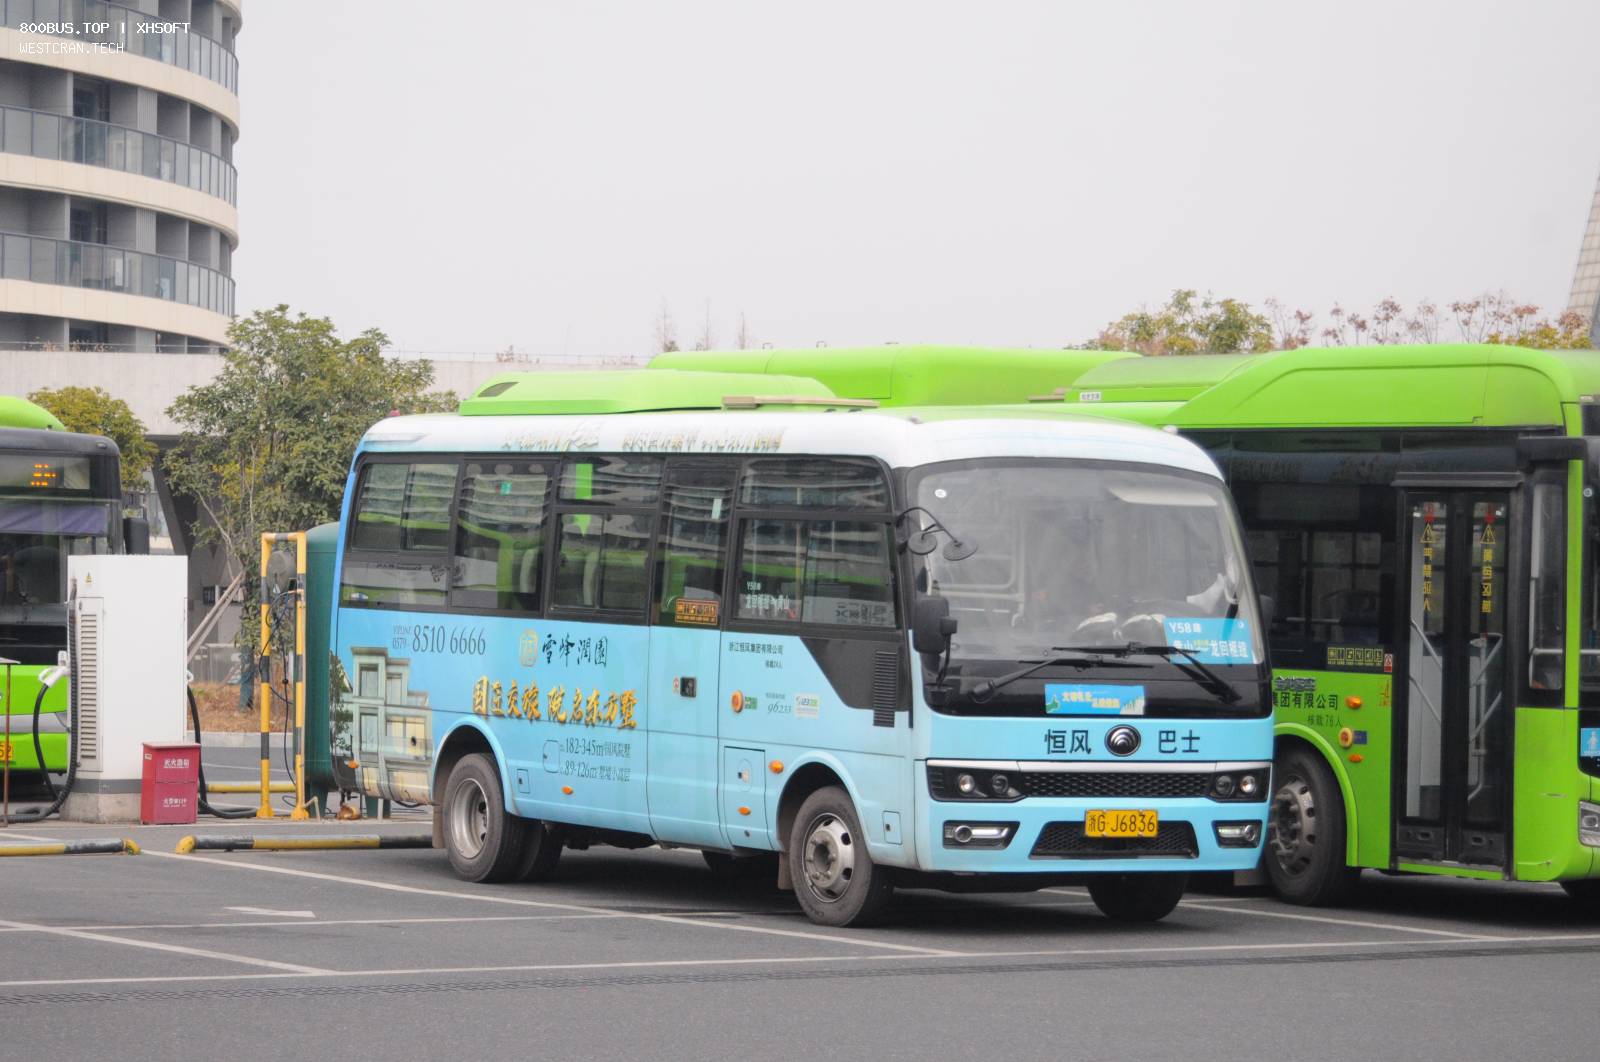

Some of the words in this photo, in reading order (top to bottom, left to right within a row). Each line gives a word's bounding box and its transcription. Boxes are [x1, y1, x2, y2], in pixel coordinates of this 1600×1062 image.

[412, 624, 446, 653] 8510
[449, 625, 486, 655] 6666
[1044, 729, 1092, 754] 恒风
[1158, 729, 1201, 754] 巴士
